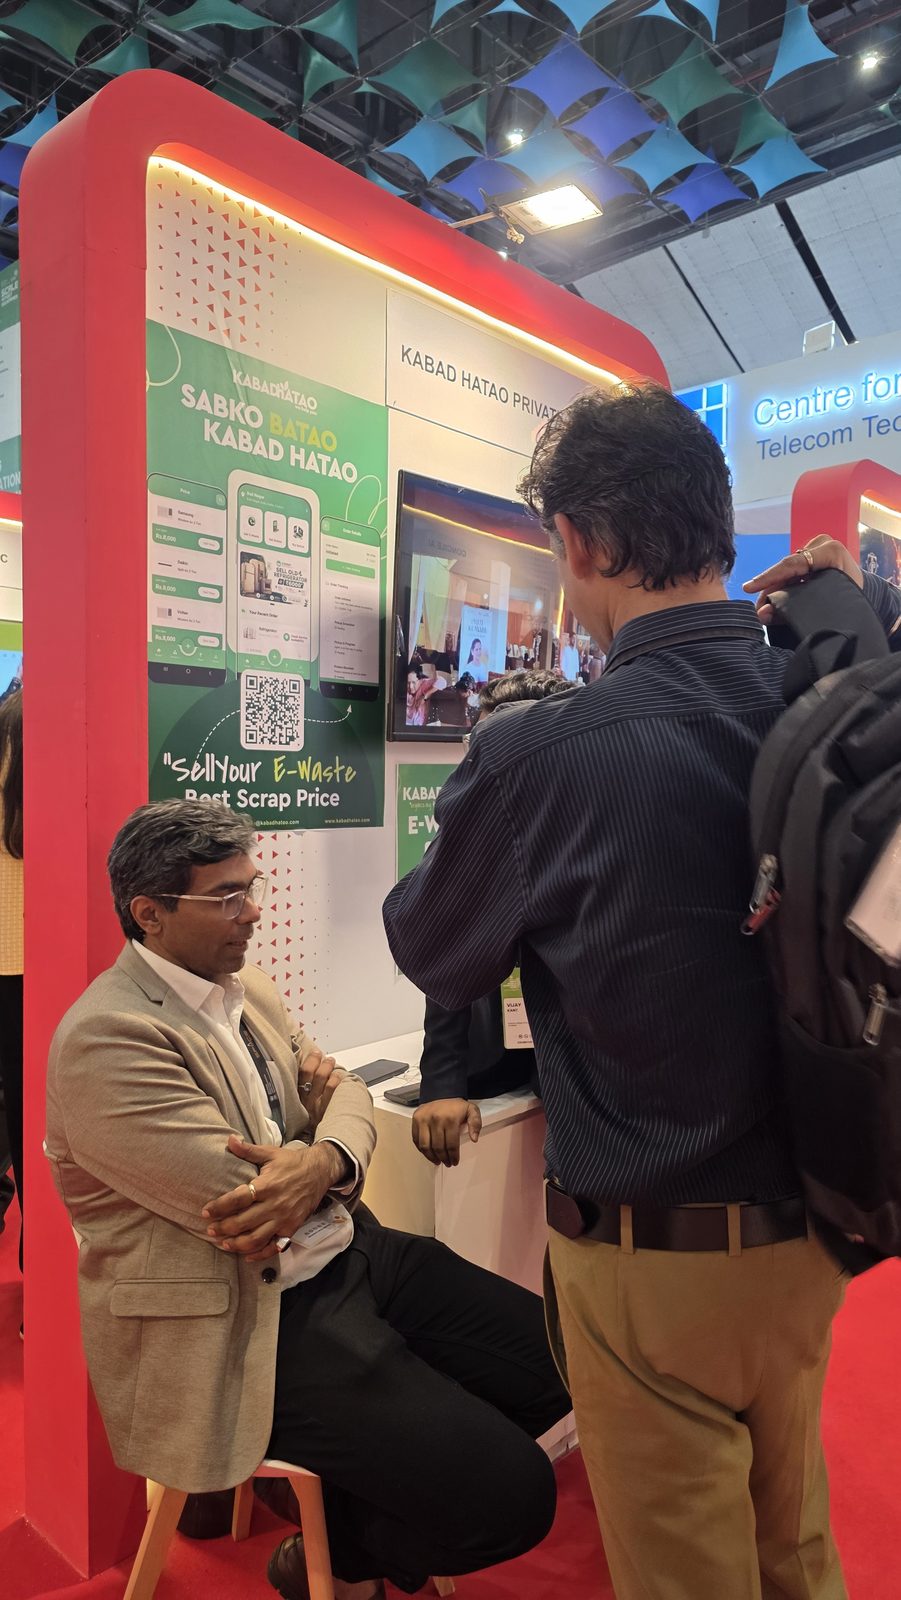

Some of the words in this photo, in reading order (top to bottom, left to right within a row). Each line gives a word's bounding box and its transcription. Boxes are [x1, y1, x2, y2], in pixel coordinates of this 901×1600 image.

[233, 370, 318, 410] KABADHATAO
[401, 345, 456, 383] KABAD
[461, 370, 509, 404] HATAO
[513, 392, 558, 420] PRIVAT
[754, 383, 854, 428] Centre
[862, 372, 901, 403] for
[181, 384, 263, 428] SABKO
[269, 413, 337, 452] BATAO
[204, 418, 284, 461] KABAD
[290, 445, 358, 483] HATAO
[757, 426, 852, 460] Telecom
[273, 755, 357, 784] E-Waste
[237, 788, 291, 811] Scrap
[297, 787, 340, 807] Price
